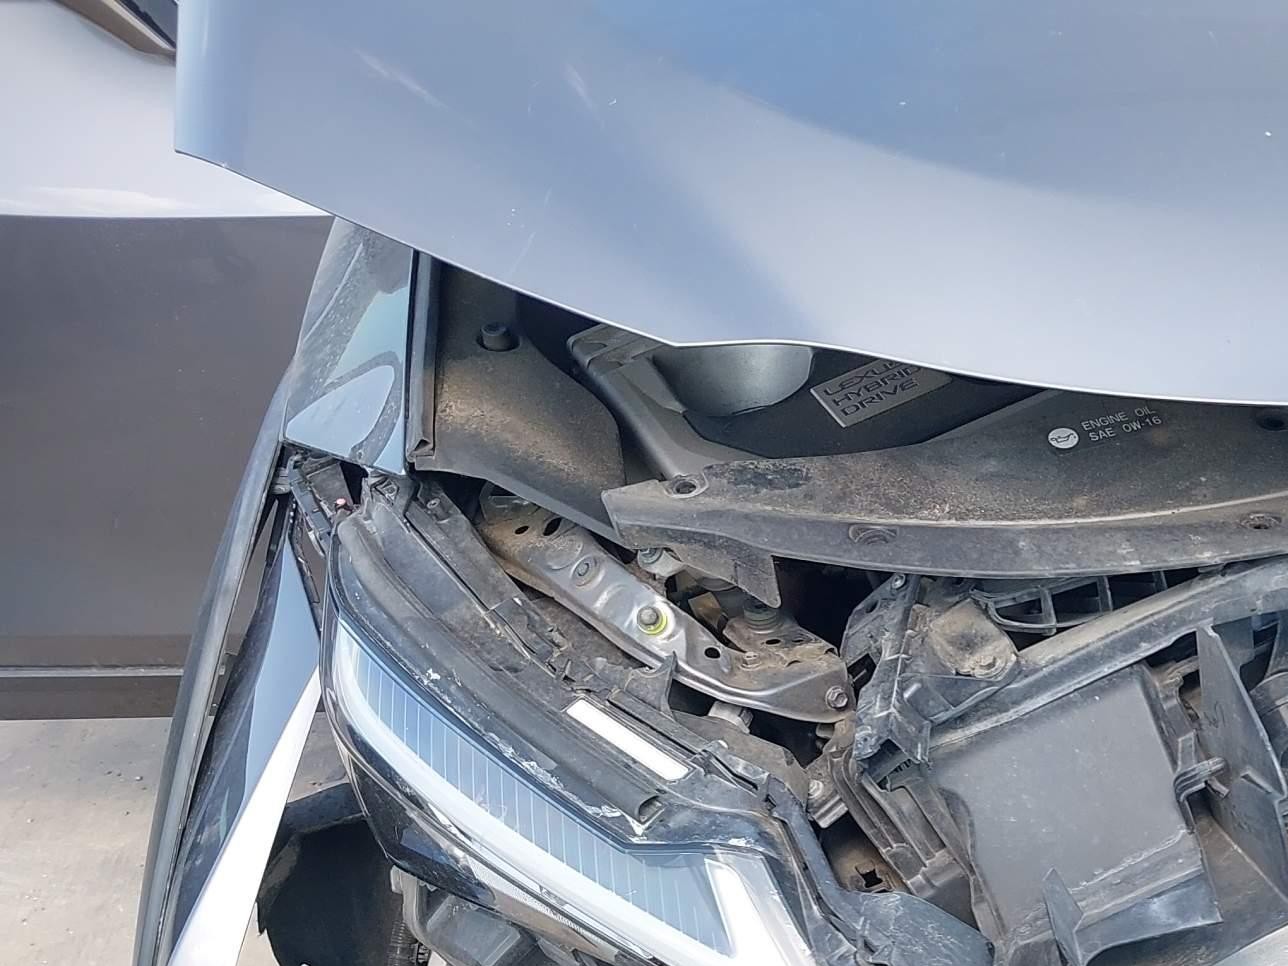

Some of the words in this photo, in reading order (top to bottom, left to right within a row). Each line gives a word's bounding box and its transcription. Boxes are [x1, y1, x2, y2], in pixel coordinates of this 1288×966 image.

[832, 367, 920, 406] HYBRID
[841, 378, 919, 416] DRIVE
[1081, 412, 1129, 431] ENGINE
[1134, 406, 1156, 417] OIL
[1088, 427, 1117, 441] SAE
